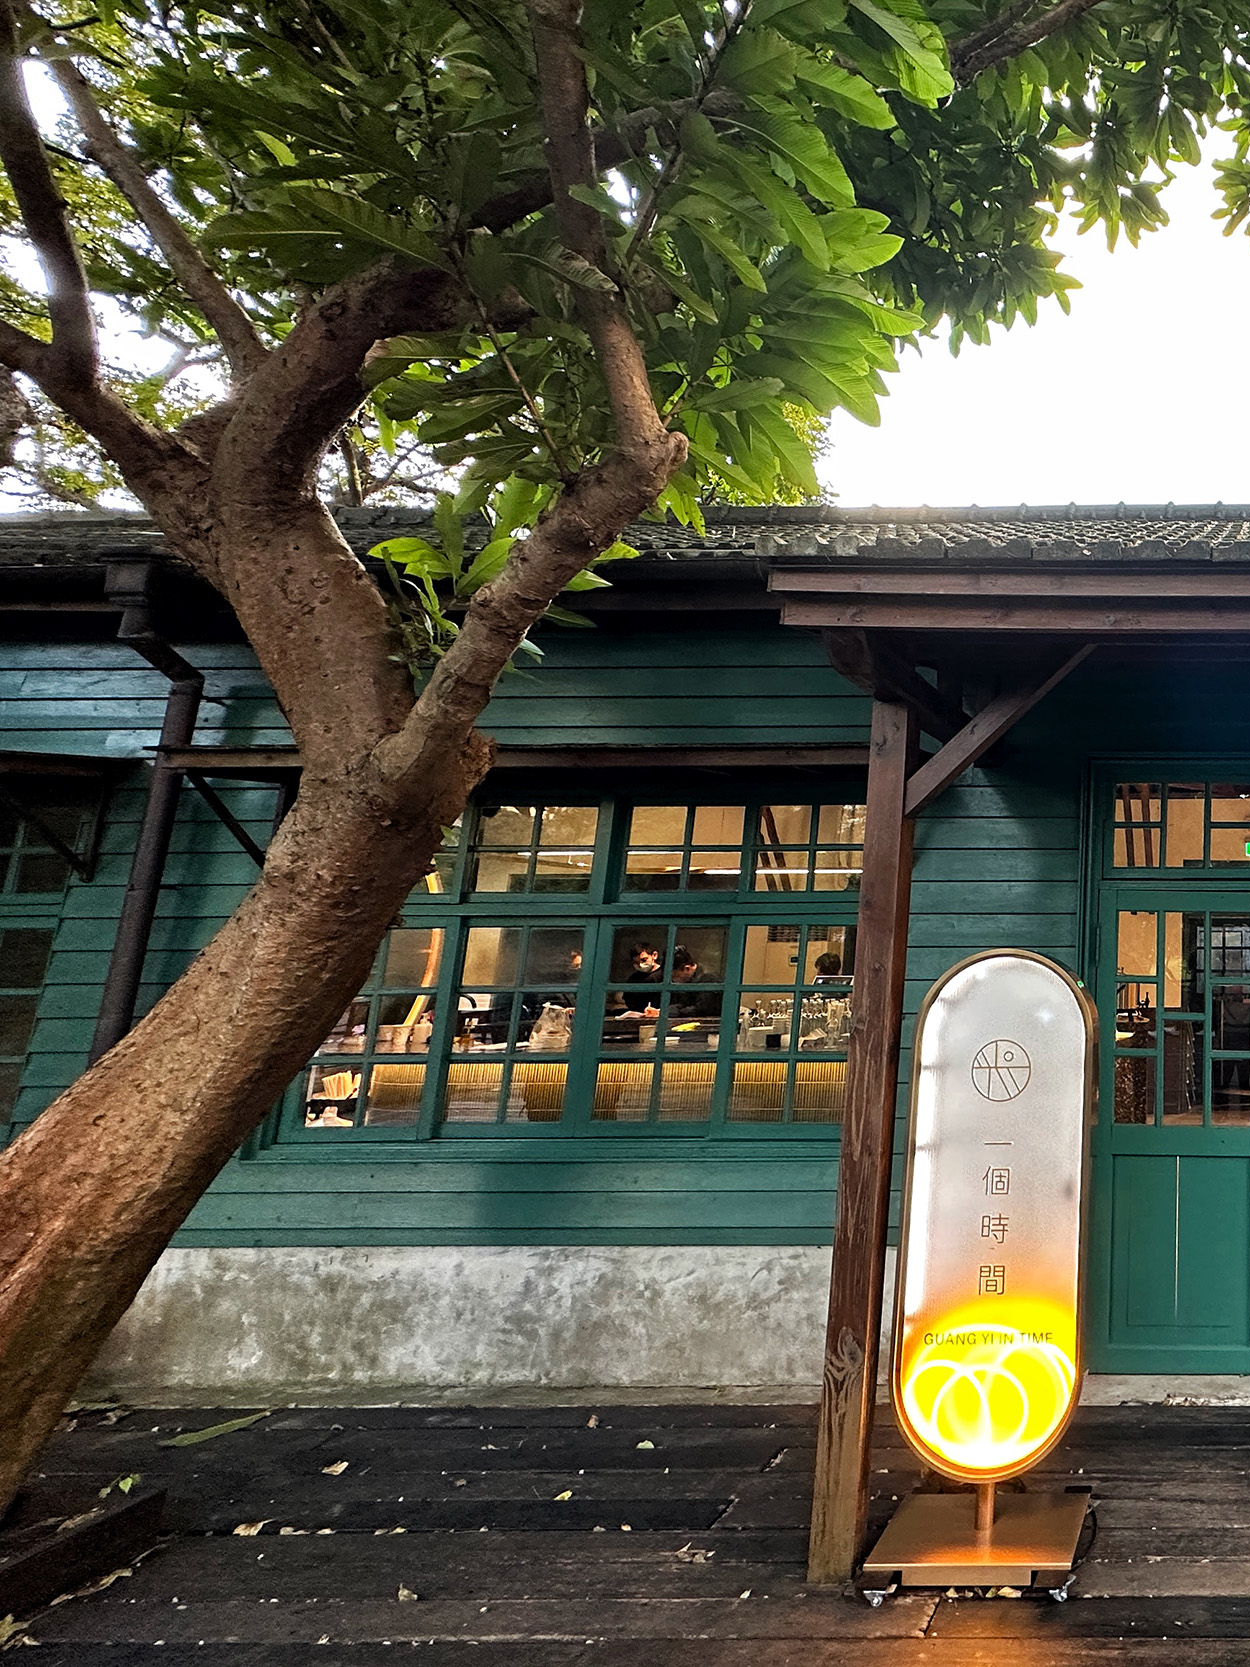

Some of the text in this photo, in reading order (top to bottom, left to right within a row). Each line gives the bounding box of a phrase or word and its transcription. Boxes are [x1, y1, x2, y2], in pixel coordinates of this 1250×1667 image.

[979, 1140, 1013, 1296] 一個時間
[923, 1331, 1053, 1346] GUANG YI IN TIME
